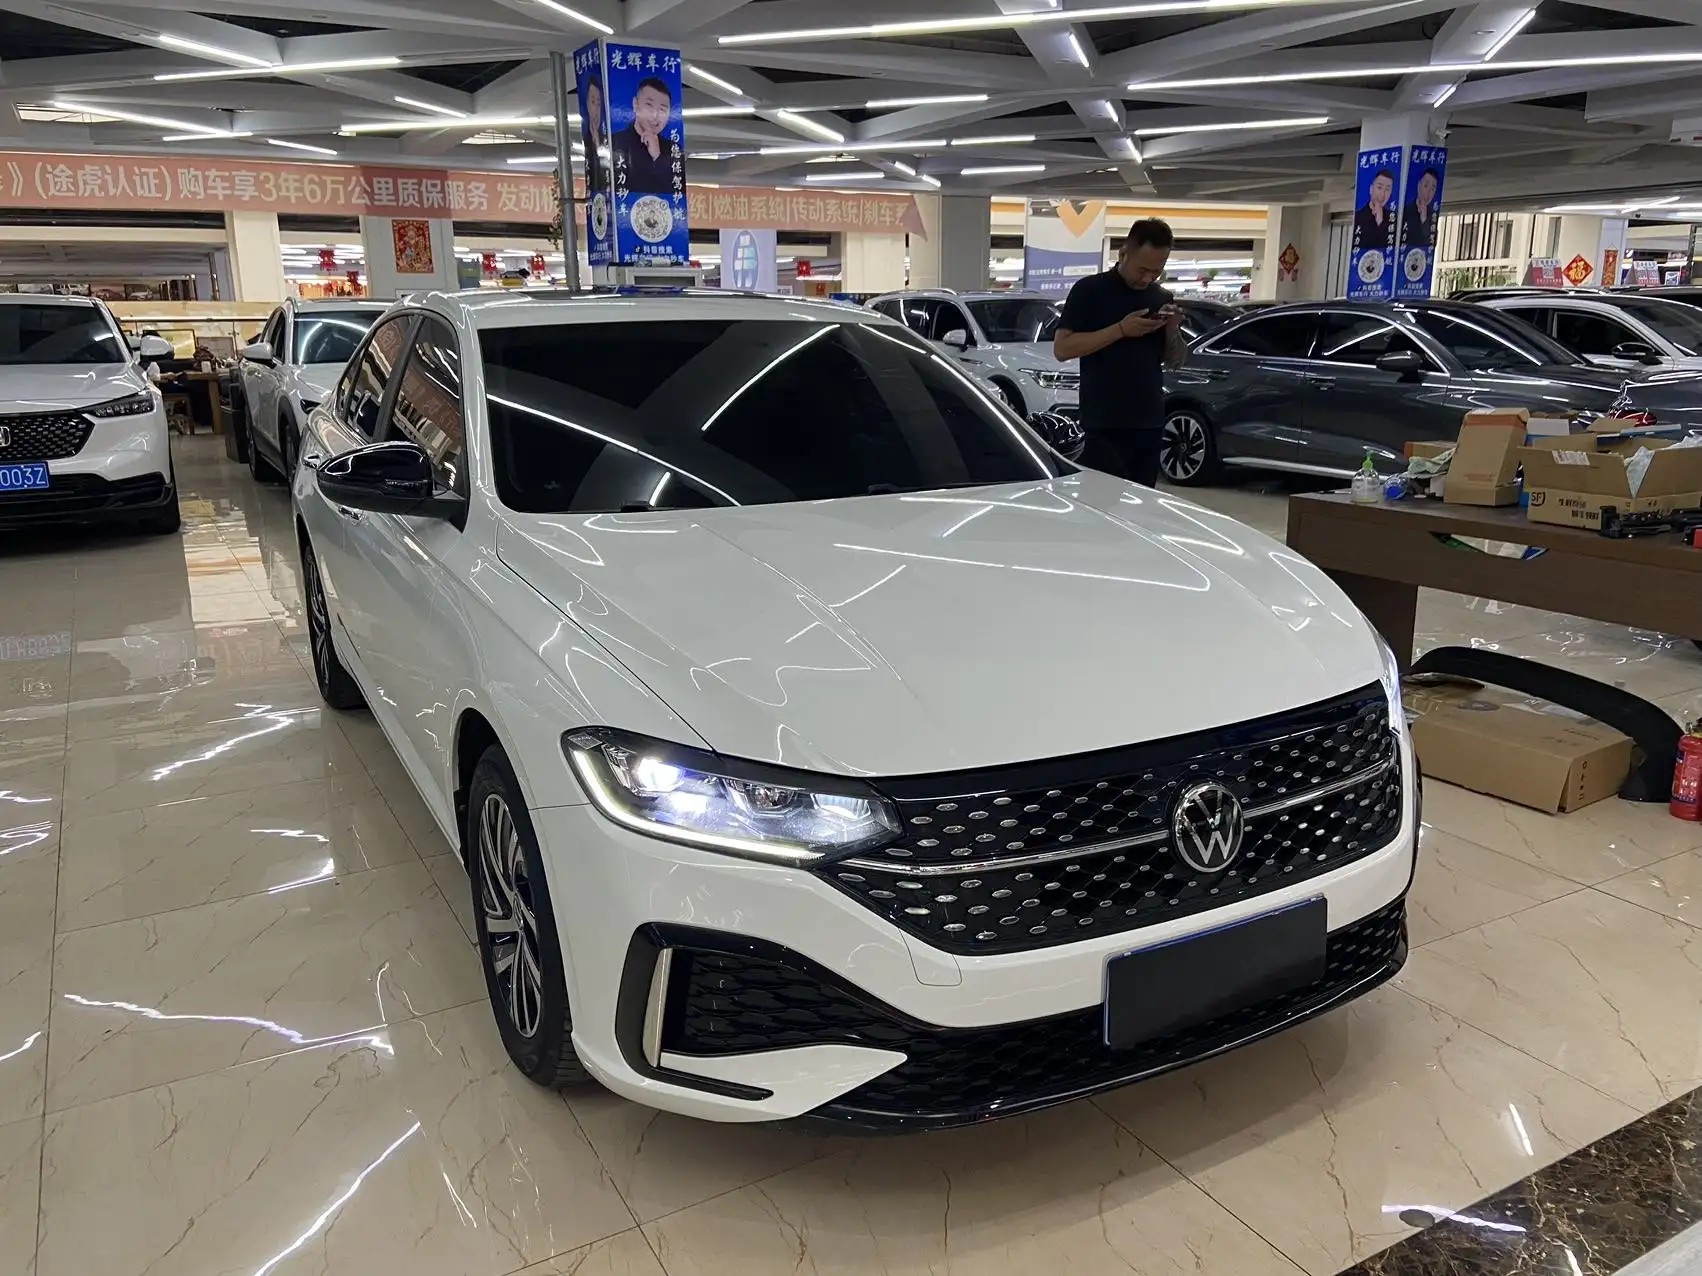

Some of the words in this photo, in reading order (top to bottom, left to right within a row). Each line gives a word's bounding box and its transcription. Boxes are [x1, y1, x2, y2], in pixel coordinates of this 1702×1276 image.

[611, 50, 681, 74] 光辉车行
[1568, 260, 1586, 280] 福
[0, 467, 46, 486] 003Z
